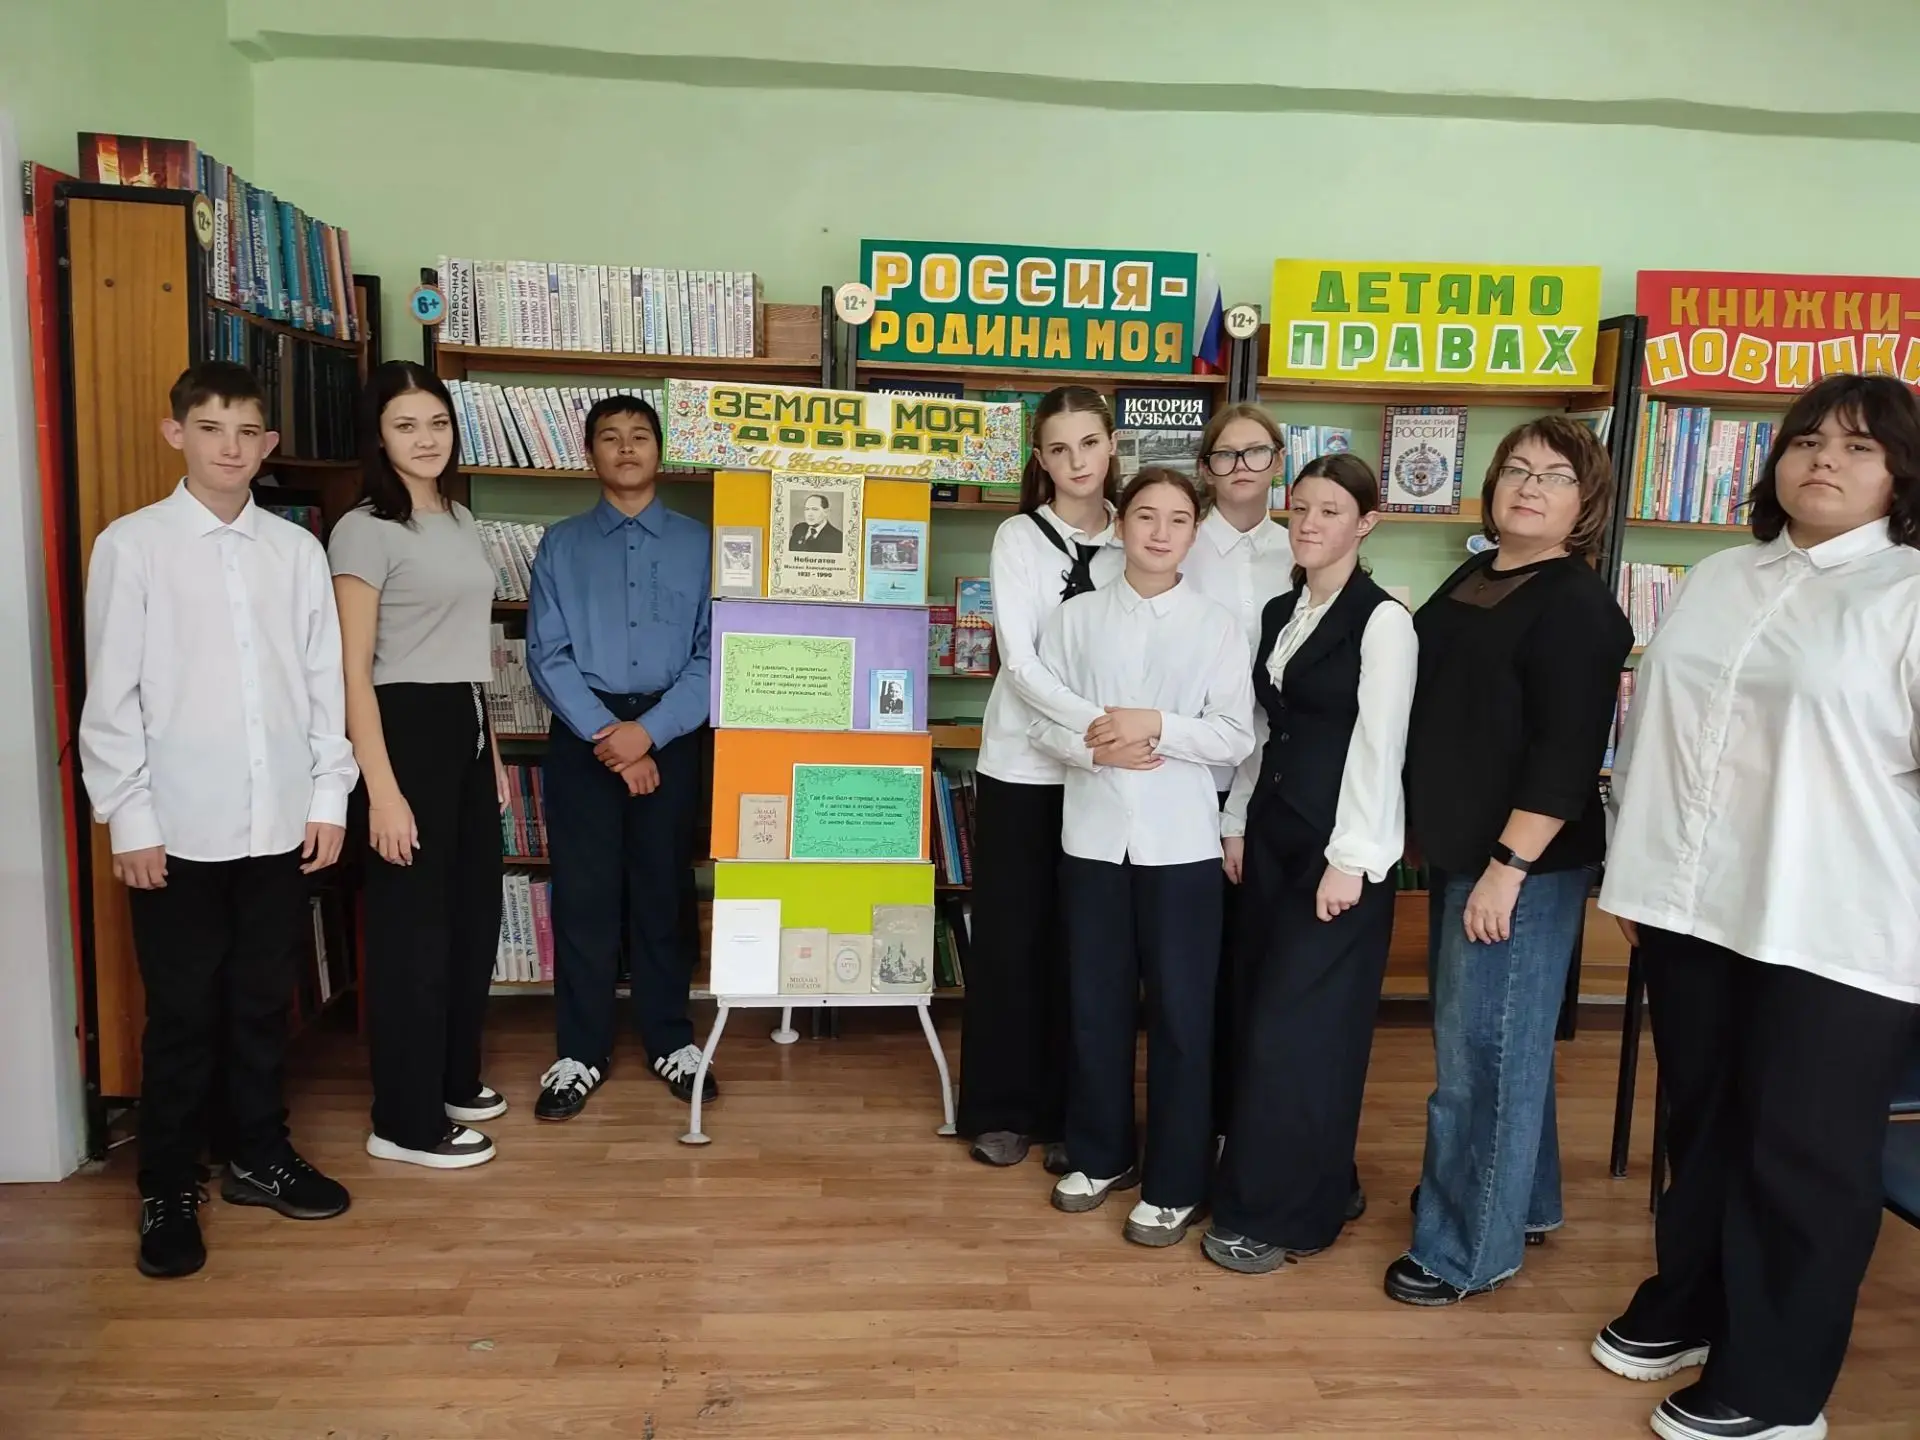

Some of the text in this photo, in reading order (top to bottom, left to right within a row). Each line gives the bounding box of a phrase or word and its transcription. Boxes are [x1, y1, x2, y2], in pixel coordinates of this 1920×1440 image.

[872, 251, 1188, 312] РОССИЯ-
[1311, 270, 1564, 316] ДЕТЯМ О
[417, 296, 440, 314] 6+
[451, 262, 460, 338] СПРАВОЧНАЯ
[461, 269, 469, 338] ЛИТЕРАТУРА
[843, 296, 867, 310] 12+
[1230, 313, 1256, 328] 12+
[870, 310, 1184, 364] РОДИНА МОЯ
[1287, 320, 1583, 375] ПРАВАХ
[713, 390, 982, 434] ЗЕМЛЯ МОЯ
[1124, 398, 1203, 413] ИСТОРИЯ
[1124, 412, 1203, 426] КУЗБАССА
[1394, 426, 1456, 438] РОССИИ
[737, 426, 959, 452] ДОБРАЯ
[793, 555, 836, 564] Небогатов
